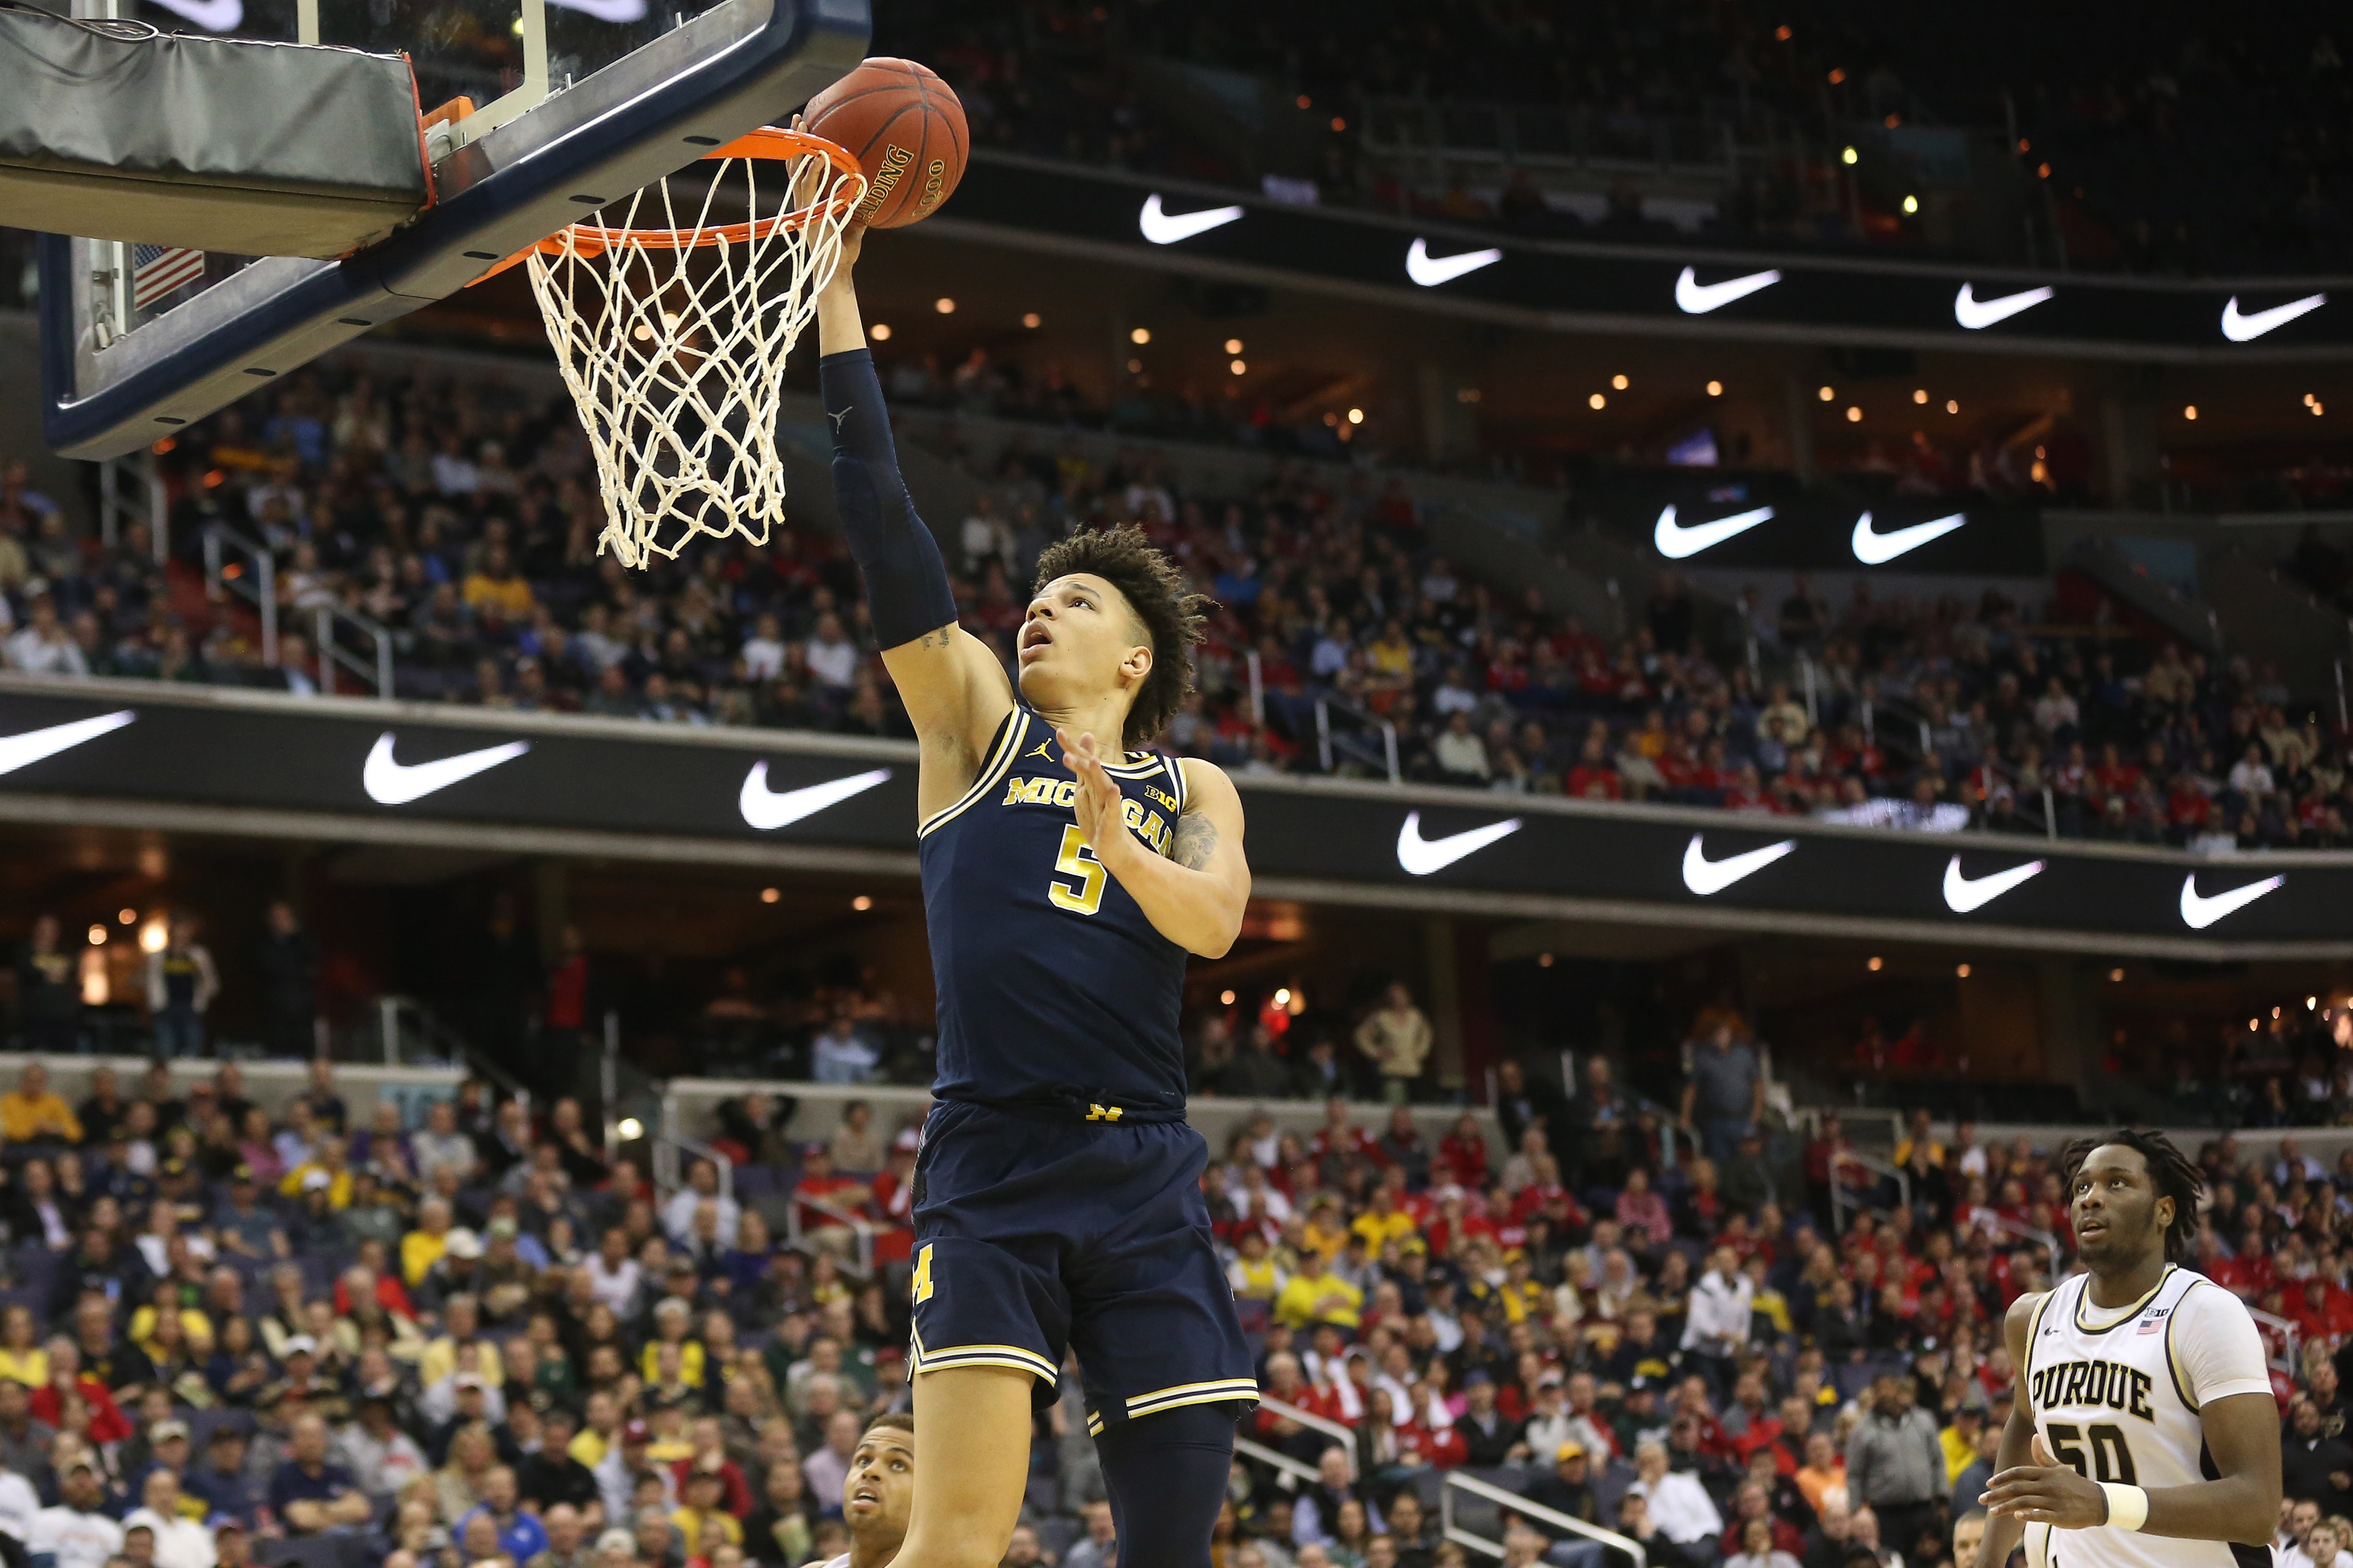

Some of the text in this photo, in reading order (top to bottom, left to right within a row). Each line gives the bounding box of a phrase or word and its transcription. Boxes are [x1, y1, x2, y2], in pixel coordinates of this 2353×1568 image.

[856, 144, 914, 224] PALDING
[1002, 776, 1173, 859] MICGAN
[1048, 823, 1107, 915] 5
[1086, 1103, 1123, 1121] M
[2033, 1360, 2155, 1425] PURDUE
[2046, 1423, 2139, 1487] 50
